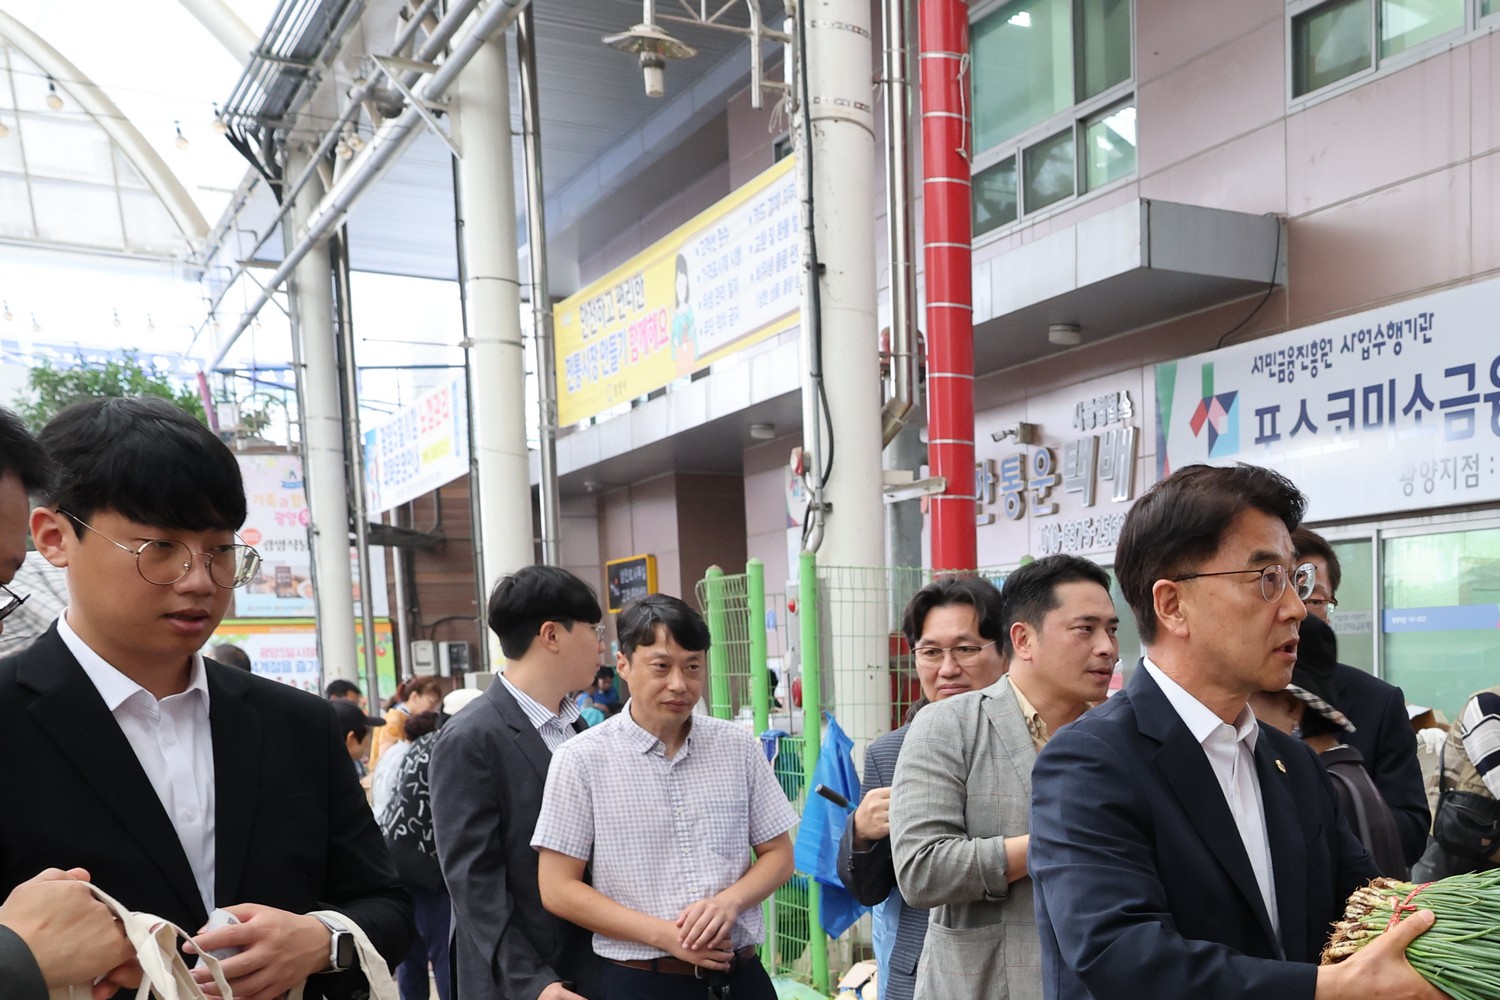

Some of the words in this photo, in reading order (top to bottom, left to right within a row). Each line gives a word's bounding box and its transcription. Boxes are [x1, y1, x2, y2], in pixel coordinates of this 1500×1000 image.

[566, 345, 598, 391] 전통시장
[600, 331, 627, 376] 만들기
[629, 308, 668, 363] 함께해요
[580, 291, 615, 339] 안전하고
[1251, 338, 1333, 383] 서민금융진흥원
[1340, 312, 1434, 361] 사업수행기관
[1063, 426, 1139, 508] 택배
[1399, 452, 1480, 498] 광양지점
